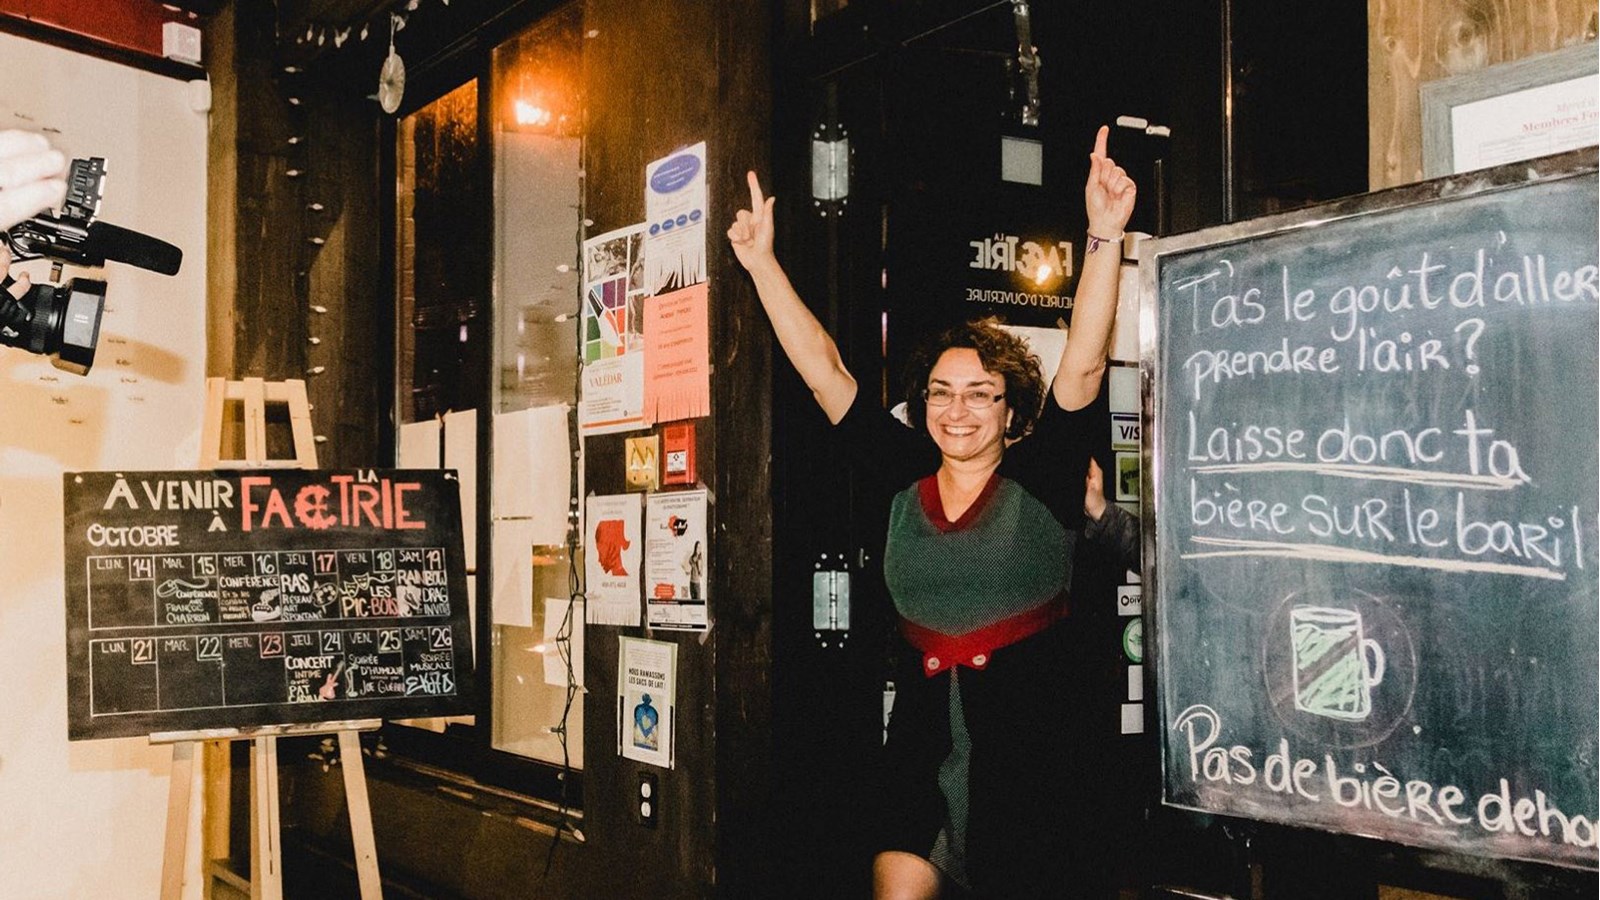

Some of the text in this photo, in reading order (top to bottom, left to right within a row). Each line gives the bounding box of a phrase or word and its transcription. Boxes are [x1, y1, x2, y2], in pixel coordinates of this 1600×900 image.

[1172, 260, 1265, 333] T'as
[1283, 265, 1316, 321] le
[1329, 252, 1446, 341] goût
[1188, 409, 1531, 482] Laisse donc ta
[358, 469, 379, 483] LA
[208, 510, 228, 532] À
[1403, 488, 1448, 547] le
[87, 523, 180, 547] OCTOBRE
[133, 558, 152, 577] 14
[197, 556, 216, 575] 15
[256, 554, 275, 574] 16
[317, 553, 335, 572] 17
[376, 550, 393, 570] 18
[425, 550, 441, 570] 19
[280, 573, 311, 594] RAS
[370, 585, 392, 598] LES
[422, 587, 449, 603] DRAG
[200, 637, 221, 657] 22
[262, 635, 282, 655] 23
[323, 632, 341, 651] 24
[380, 630, 400, 650] 25
[432, 627, 452, 648] 26
[133, 640, 152, 661] 21
[285, 655, 335, 670] CONCERT
[288, 685, 311, 698] PAT
[1173, 704, 1257, 784] Pas
[1264, 737, 1319, 802] de
[1478, 778, 1599, 848] deho
